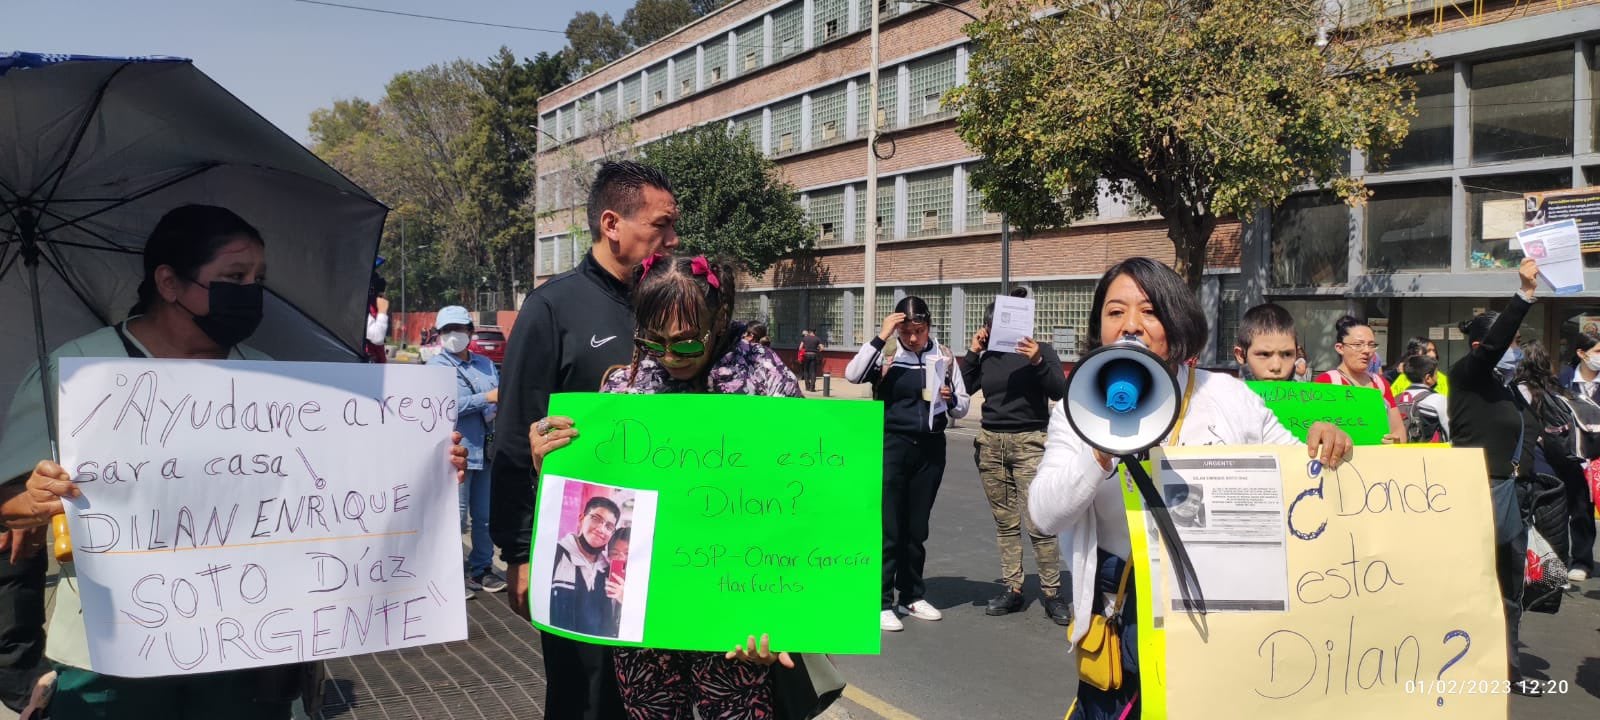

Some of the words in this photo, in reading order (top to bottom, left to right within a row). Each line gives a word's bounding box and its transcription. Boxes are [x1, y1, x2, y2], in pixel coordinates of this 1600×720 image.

[342, 397, 369, 427] a
[374, 392, 457, 434] regre
[71, 457, 151, 484] sar
[160, 454, 184, 481] a
[594, 417, 749, 470] ¿Dónde
[776, 436, 846, 467] esta
[78, 502, 240, 554] DILAN
[249, 482, 410, 539] ENRIQUE
[687, 479, 805, 519] Dilan?
[119, 562, 270, 629] SOTO
[1295, 531, 1405, 605] esta
[1253, 614, 1472, 708] Dilan?
